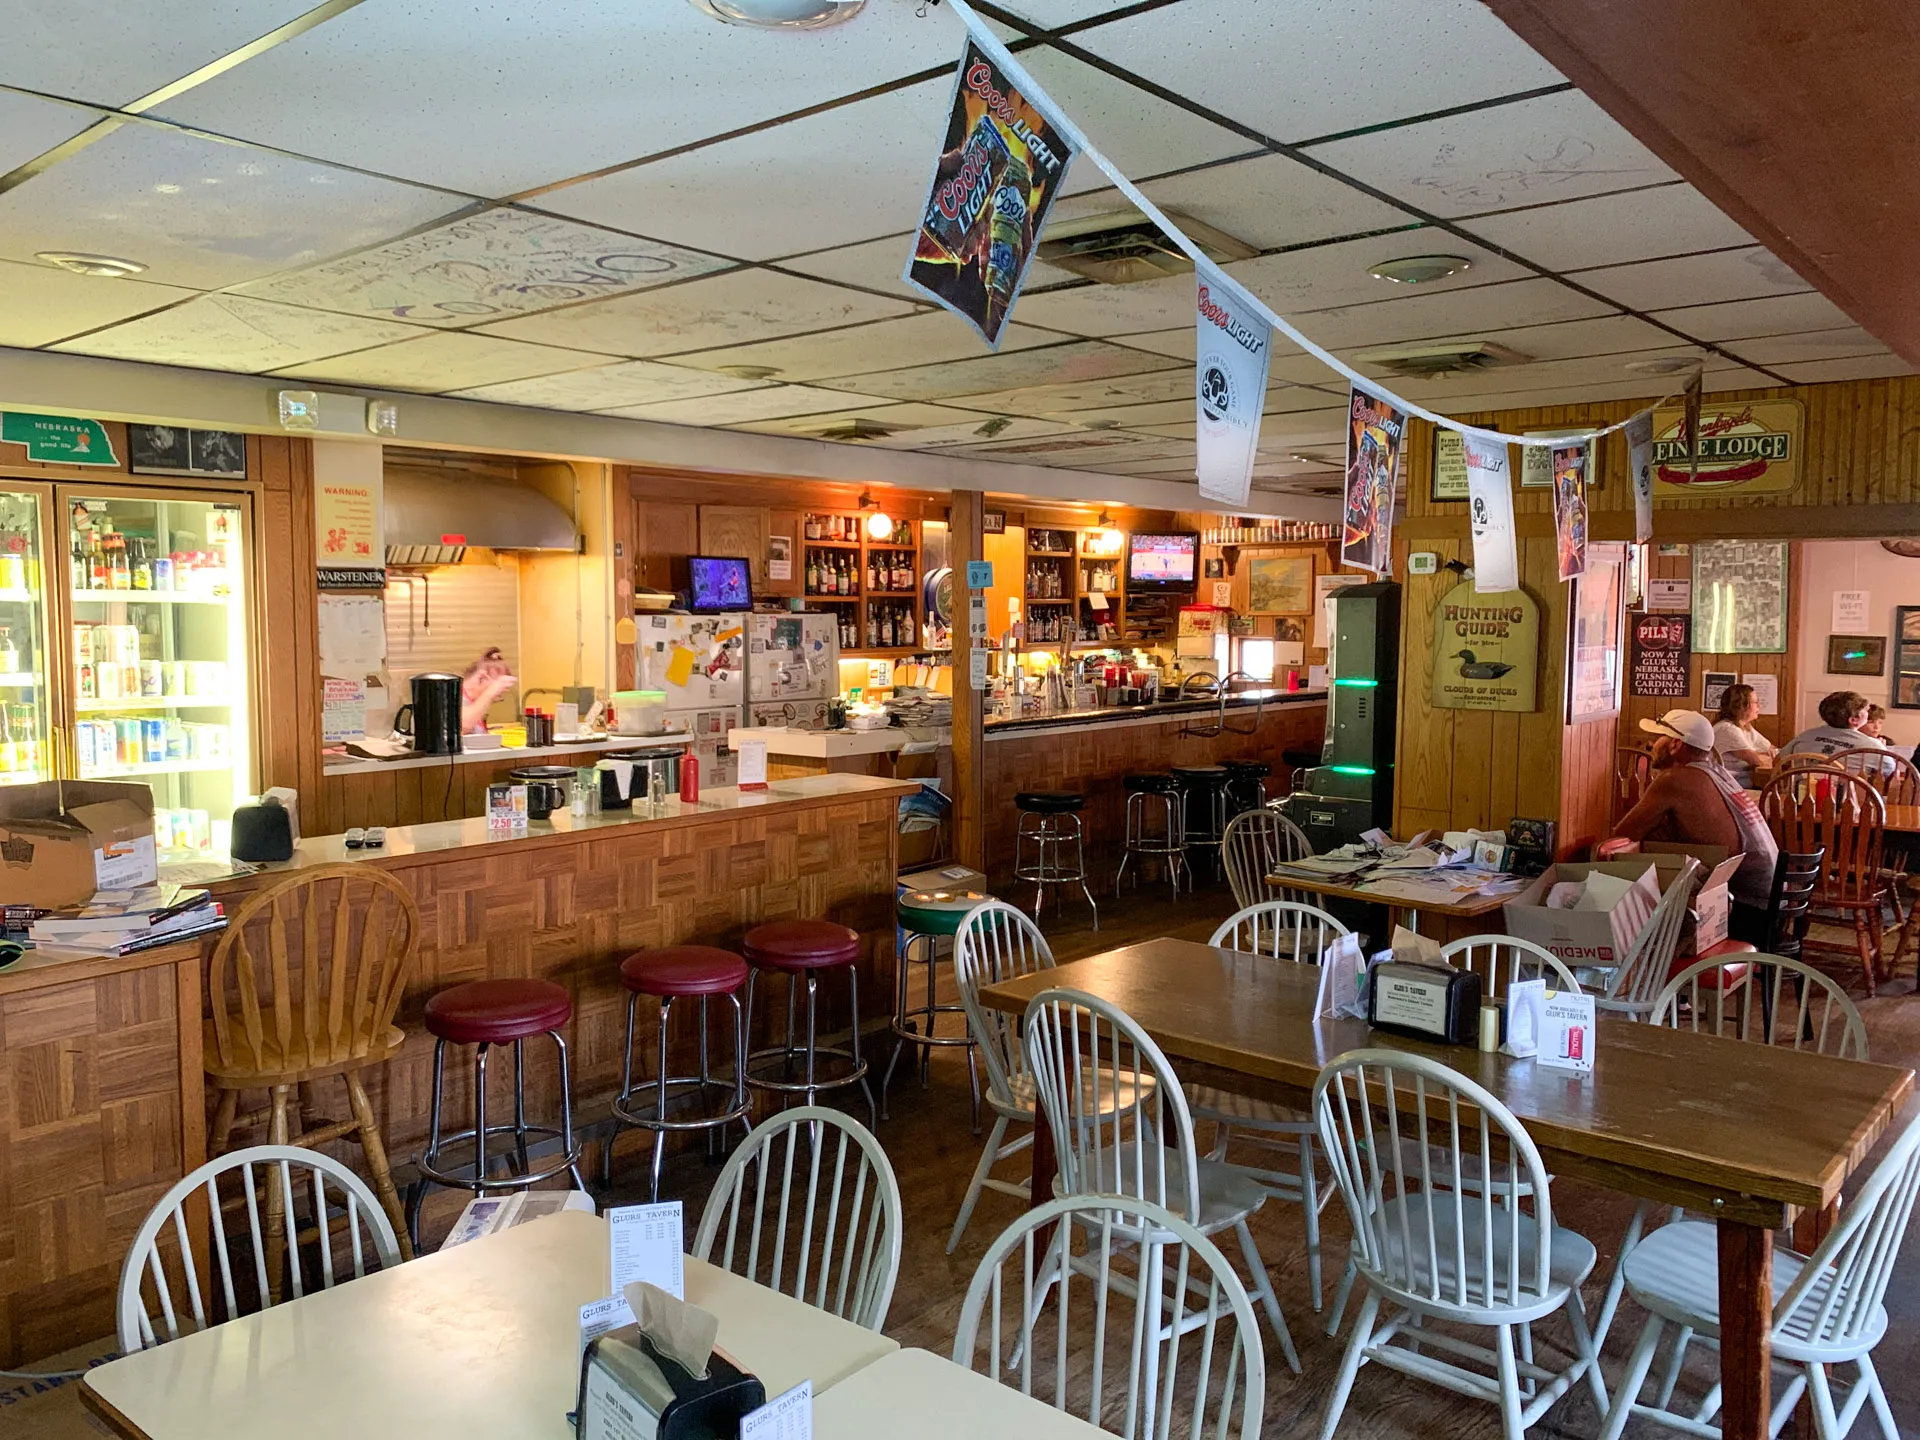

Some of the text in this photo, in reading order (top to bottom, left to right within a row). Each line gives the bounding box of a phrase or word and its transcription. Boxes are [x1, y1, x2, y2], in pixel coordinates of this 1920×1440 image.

[967, 57, 1061, 175] Coors LIGHT
[936, 145, 989, 221] Coors
[957, 167, 993, 237] LIGHT
[1198, 284, 1264, 353] Coors LIGHT
[1352, 396, 1401, 437] Coors LIGHT
[35, 422, 90, 433] NEBRASKA
[1716, 436, 1785, 458] LODGE
[317, 571, 382, 582] WARSTEINER
[1444, 605, 1524, 624] HUNTING
[1455, 621, 1510, 638] GUIDE
[1640, 626, 1669, 639] PILS
[1641, 651, 1665, 659] NOW
[1642, 658, 1678, 666] GLUR'S!
[1634, 665, 1685, 673] NEBRASKA
[1444, 685, 1474, 693] CLOUDS
[1490, 688, 1518, 696] DUCKS
[1635, 680, 1686, 688] CARDINAL
[1637, 687, 1660, 695] PALE
[1546, 945, 1596, 958] MEDIU
[1566, 1013, 1588, 1021] TAVERN
[612, 1213, 641, 1224] GLURS
[646, 1209, 680, 1219] TAVERN
[583, 1303, 612, 1320] GLURS
[746, 1388, 808, 1433] GLURS TAVERN
